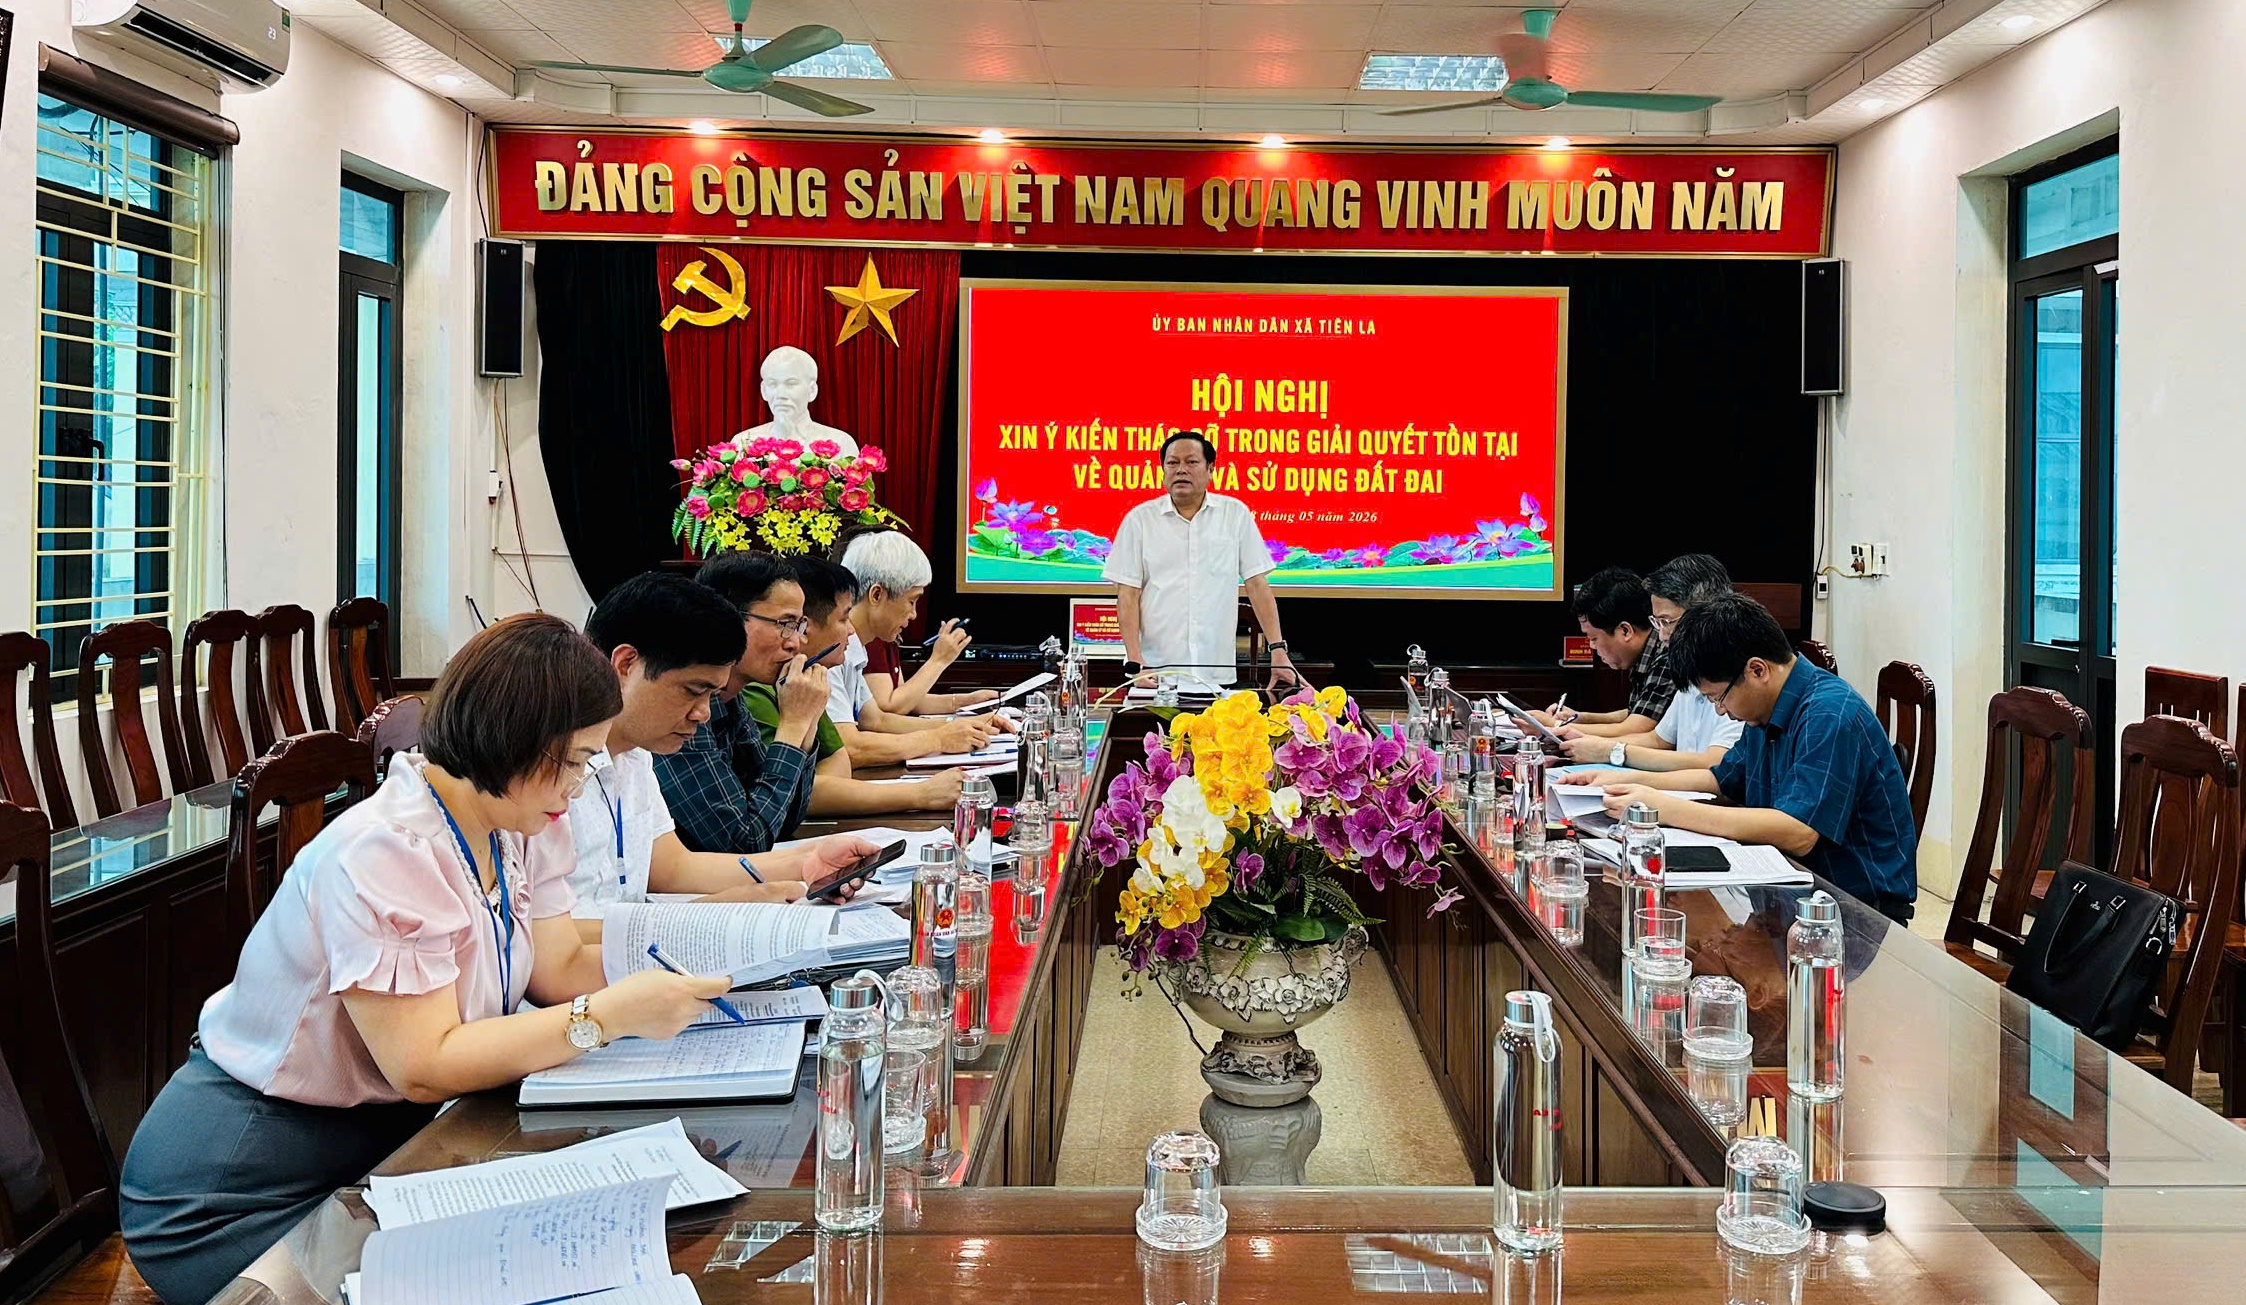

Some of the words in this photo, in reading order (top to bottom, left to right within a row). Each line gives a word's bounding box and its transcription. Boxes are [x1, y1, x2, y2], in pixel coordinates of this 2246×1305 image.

[534, 139, 675, 213] ĐẢNG
[690, 152, 828, 228] CỘNG
[843, 148, 943, 219] SẢN
[957, 160, 1061, 234] VIỆT
[1074, 175, 1186, 226] NAM
[1201, 178, 1362, 232] QUANG
[1375, 180, 1490, 230] VINH
[1506, 167, 1656, 231] MUÔN
[1670, 166, 1785, 231] NĂM
[1152, 313, 1171, 332] ỦY
[1177, 317, 1206, 332] BAN
[1212, 315, 1253, 333] NHÂN
[1259, 316, 1289, 333] DÂN
[1294, 317, 1313, 334] XÃ
[1318, 317, 1353, 335] TIÊN
[1358, 320, 1376, 335] LA
[1191, 372, 1243, 418] HỘI
[1254, 379, 1328, 420] NGHỊ
[998, 424, 1038, 450] XIN
[1044, 421, 1059, 450] Ý
[1065, 418, 1118, 451] KIẾN
[1224, 427, 1300, 454] TRONG
[1306, 423, 1352, 455] GIẢI
[1358, 422, 1429, 457] QUYẾT
[1432, 422, 1477, 457] TỒN
[1482, 431, 1519, 461] TẠI
[1073, 456, 1102, 489] VỀ
[1212, 461, 1240, 491] VÀ
[1246, 460, 1279, 492] SỬ
[1284, 467, 1348, 497] DỤNG
[1353, 460, 1399, 493] ĐẤT
[1403, 468, 1443, 494] ĐAI
[1259, 510, 1295, 523] tháng
[1298, 511, 1314, 522] 05
[1317, 510, 1344, 522] năm
[1348, 511, 1378, 523] 2026
